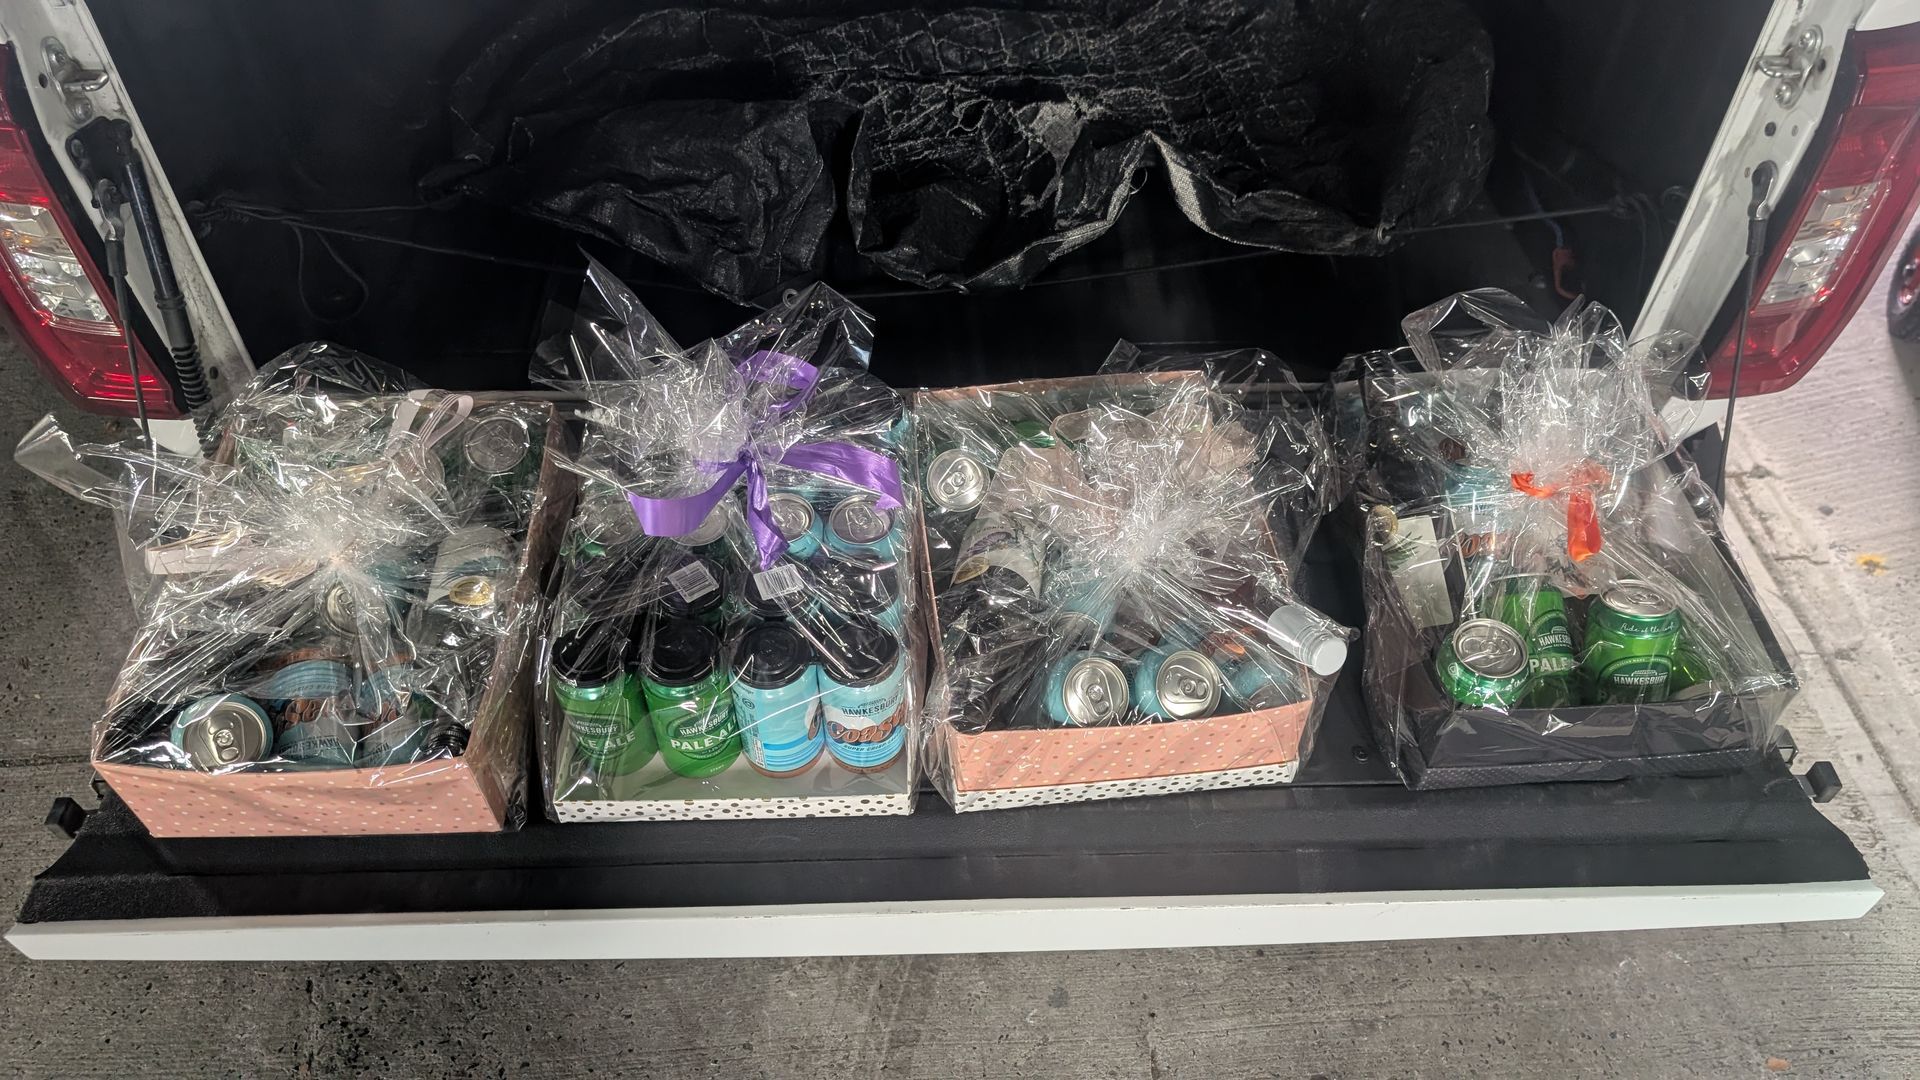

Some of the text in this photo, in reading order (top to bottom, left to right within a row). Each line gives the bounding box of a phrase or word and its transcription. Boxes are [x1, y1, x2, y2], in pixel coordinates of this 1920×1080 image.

[1529, 656, 1569, 673] PALE
[1613, 675, 1668, 685] HAWKESBURY
[841, 695, 899, 716] HAWKESBURY
[680, 708, 729, 737] HAWKESBURY
[603, 730, 636, 749] ALE
[671, 738, 714, 751] PALE
